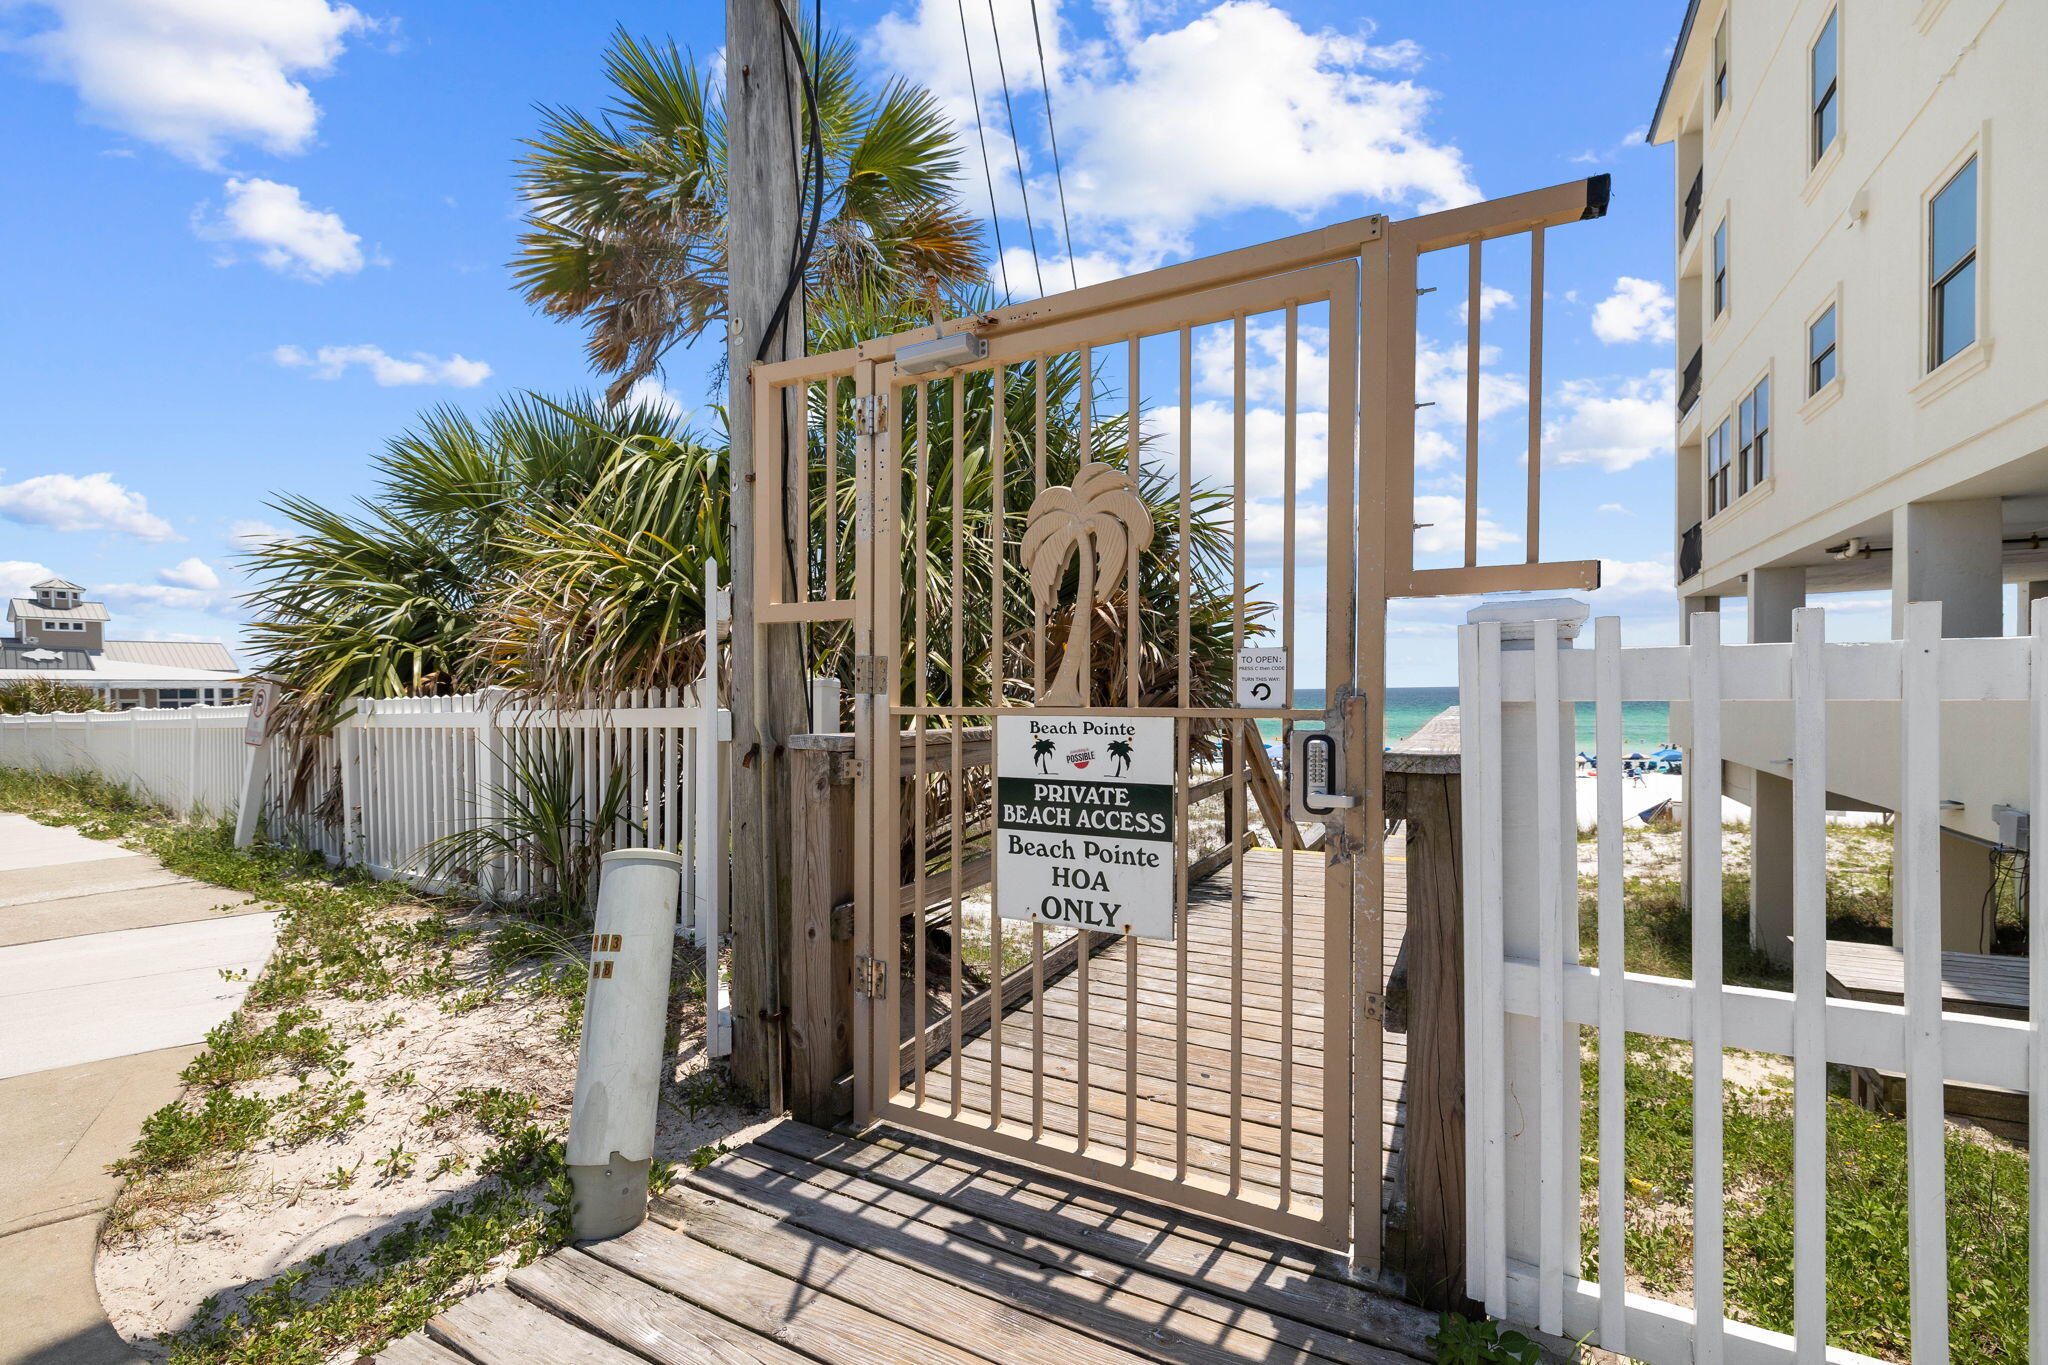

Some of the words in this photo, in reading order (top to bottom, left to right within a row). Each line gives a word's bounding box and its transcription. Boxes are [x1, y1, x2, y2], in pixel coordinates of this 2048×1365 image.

[1029, 720, 1078, 735] Beach
[1082, 721, 1136, 736] Pointe
[1066, 751, 1095, 763] POSSIBLE
[1034, 783, 1131, 807] PRIVATE
[1003, 804, 1071, 827] BEACH
[1075, 809, 1166, 834] ACCESS
[1008, 834, 1076, 860] Beach
[1083, 840, 1160, 868] Pointe
[1051, 866, 1110, 893] HOA
[1041, 896, 1122, 928] ONLY
